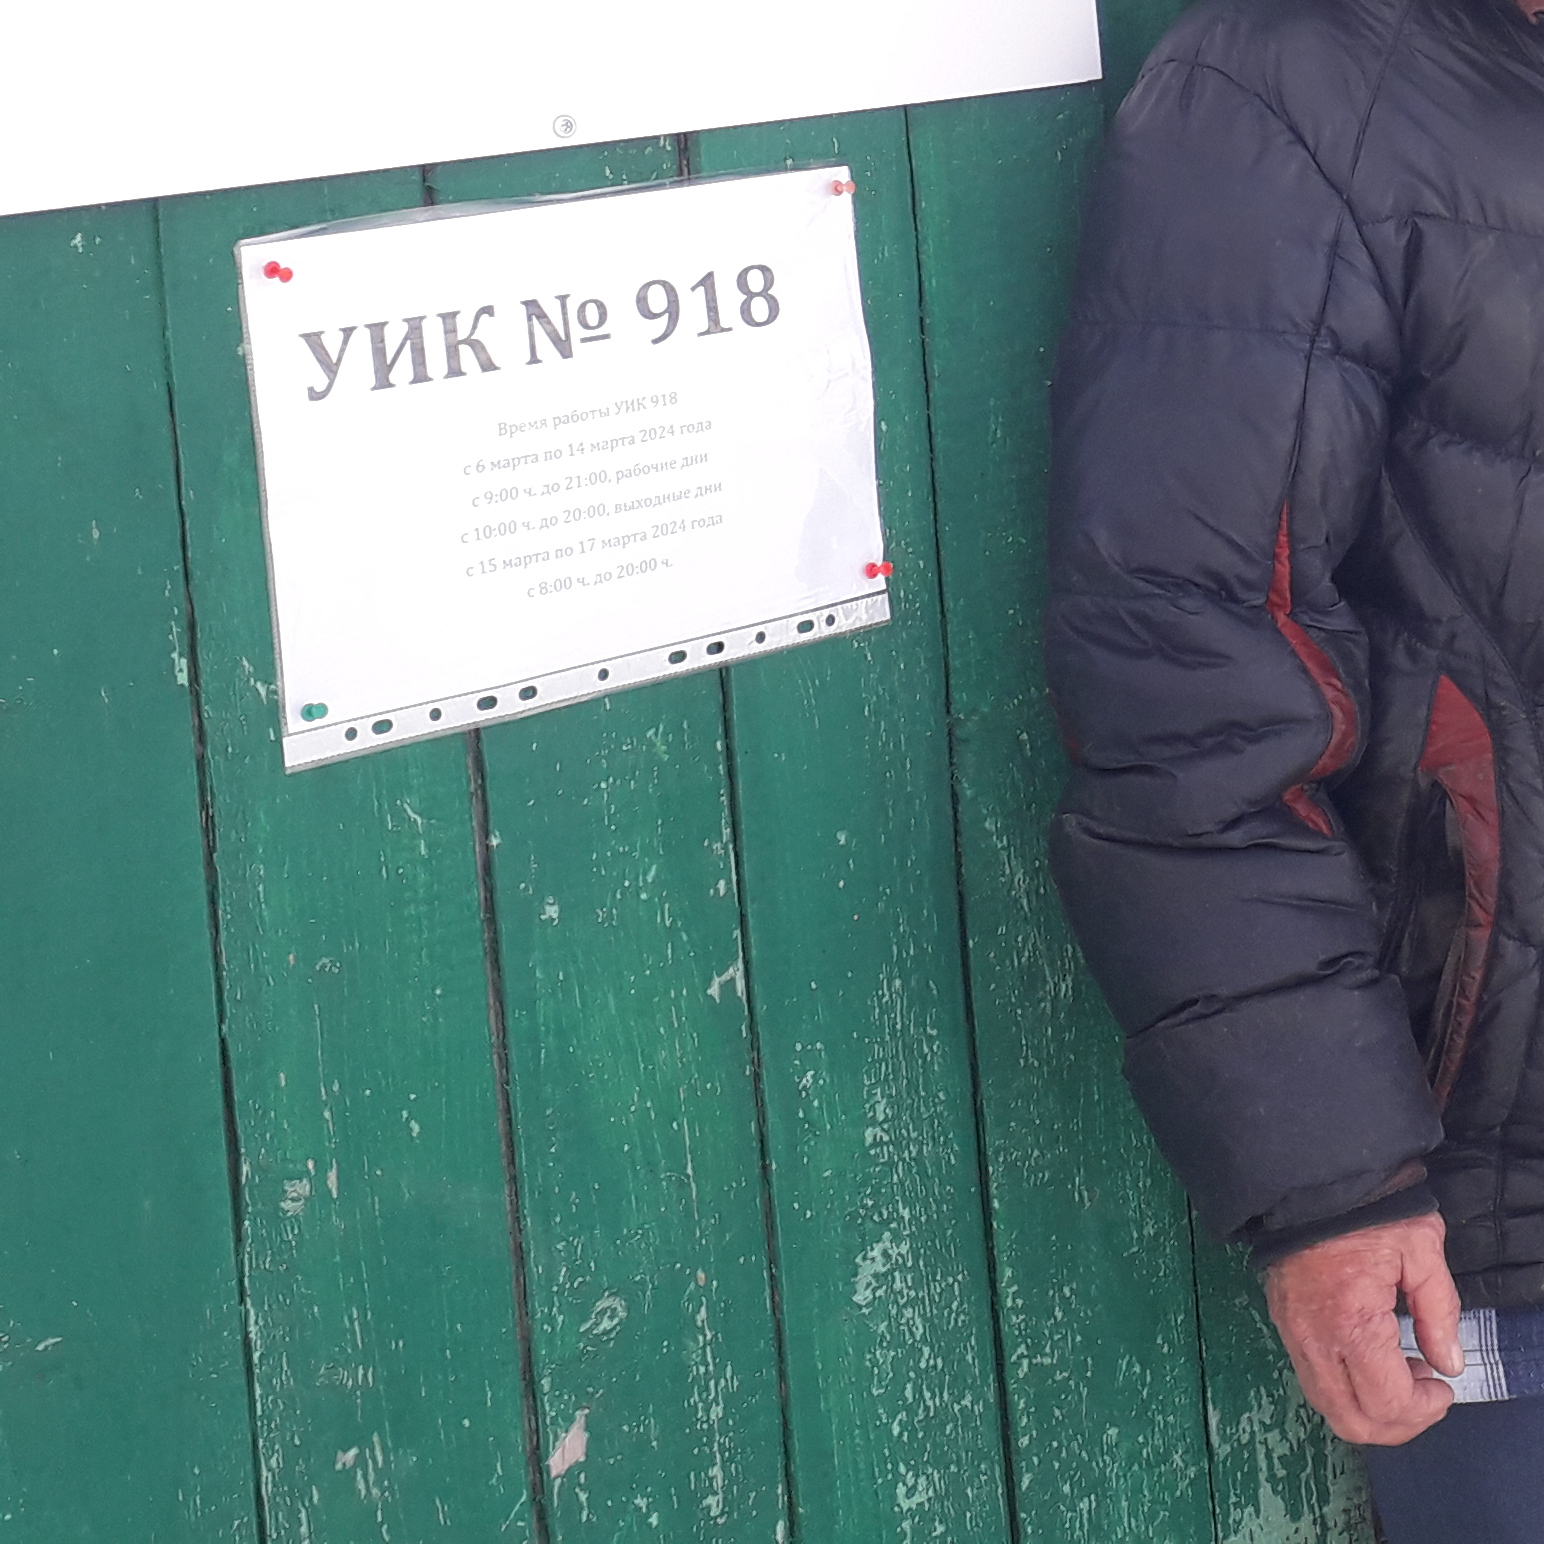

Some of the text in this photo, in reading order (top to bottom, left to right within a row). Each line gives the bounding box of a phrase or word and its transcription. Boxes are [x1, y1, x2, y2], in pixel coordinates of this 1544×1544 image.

[298, 263, 781, 402] УИК № 918
[497, 391, 678, 439] Время работы УИК 918
[463, 420, 712, 476] с 6 марта по 14 марта 2024 года
[471, 452, 708, 508] с 9:00 ч. до 21:00, рабочие дни
[460, 481, 723, 544] с 10:00 ч. до 20:00, выходные дни
[465, 514, 723, 578] с 15 марта по 17 марта 2024 года
[526, 557, 674, 598] с 8:00 ч. до 20:00 ч.
